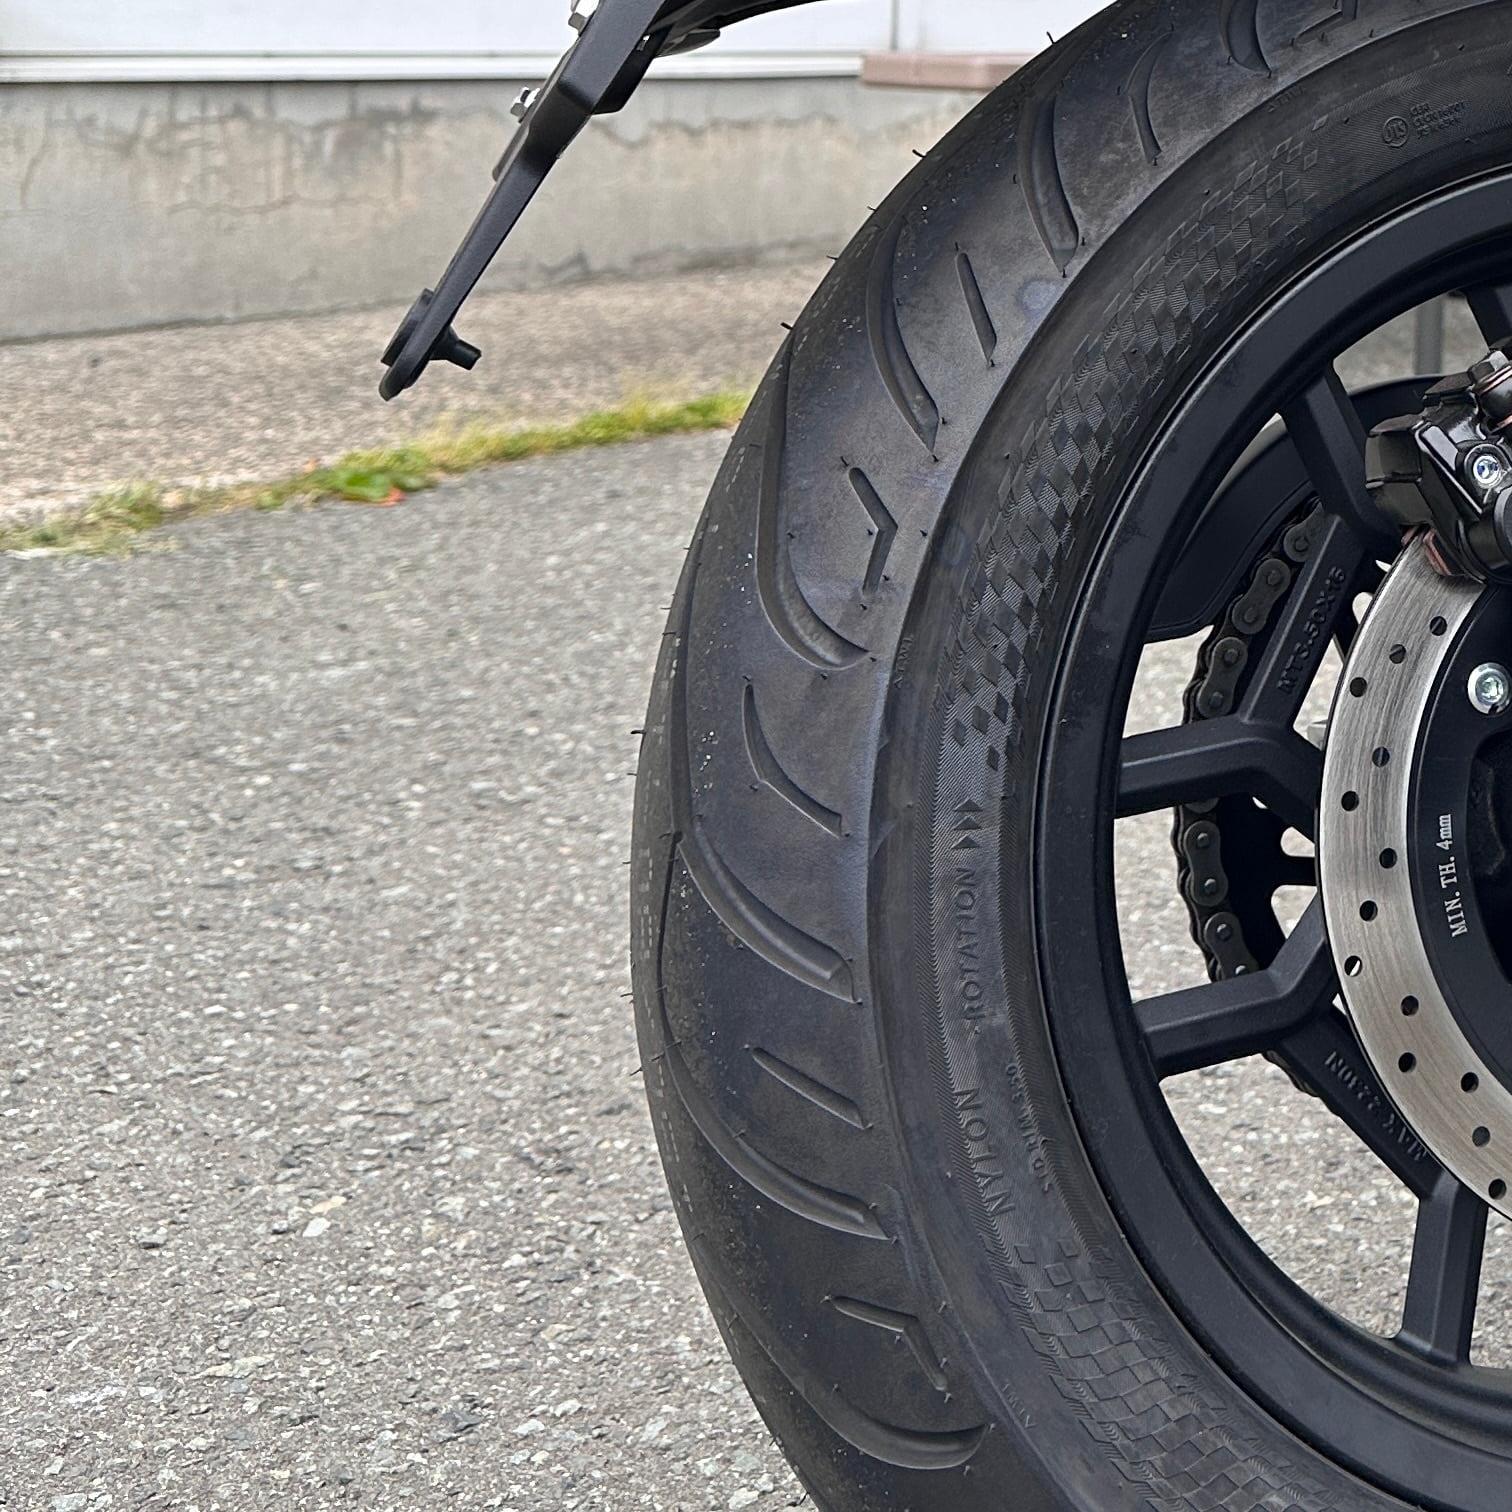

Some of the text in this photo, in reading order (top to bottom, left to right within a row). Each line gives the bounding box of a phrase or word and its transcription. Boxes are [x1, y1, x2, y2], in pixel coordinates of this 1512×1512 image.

[1436, 813, 1468, 938] MIN. TH. 4mm
[953, 867, 987, 1022] ROTATION
[952, 1088, 1017, 1218] NYLON
